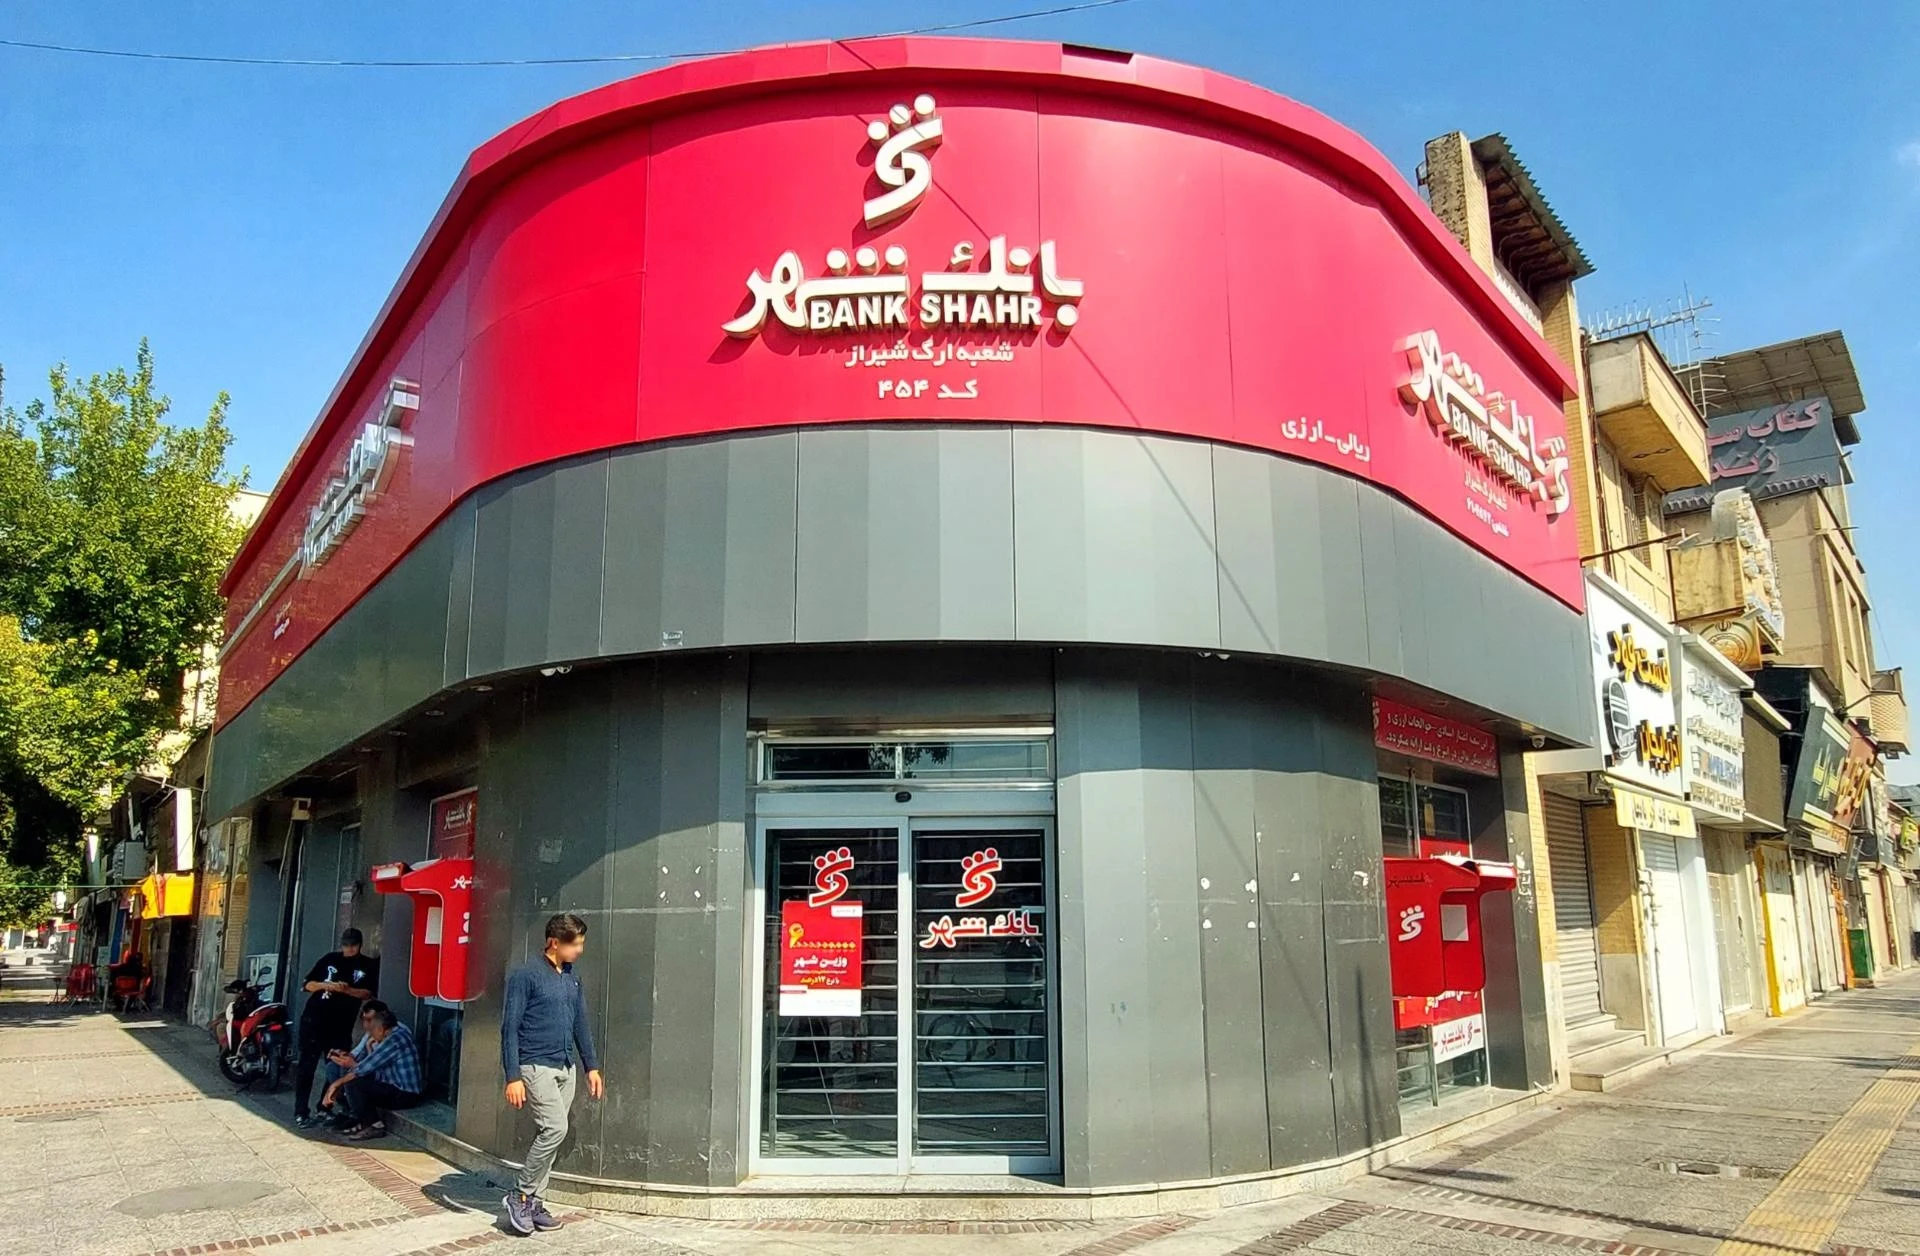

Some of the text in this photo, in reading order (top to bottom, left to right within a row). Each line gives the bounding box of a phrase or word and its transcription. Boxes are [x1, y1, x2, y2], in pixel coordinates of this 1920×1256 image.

[720, 234, 1085, 338] بانک شهر
[809, 293, 1044, 330] BANK SHAHR
[844, 339, 908, 367] شیراز
[956, 340, 1014, 368] شعبه
[877, 379, 979, 400] کد ۴۵۴
[1397, 329, 1489, 425] شهر
[1746, 400, 1822, 444] کتاب
[1450, 402, 1533, 489] BANK SHAHR
[1609, 624, 1638, 681] فود
[1636, 648, 1672, 693] فست
[919, 911, 1039, 949] بانک شهر
[793, 954, 848, 969] وزین شهر
